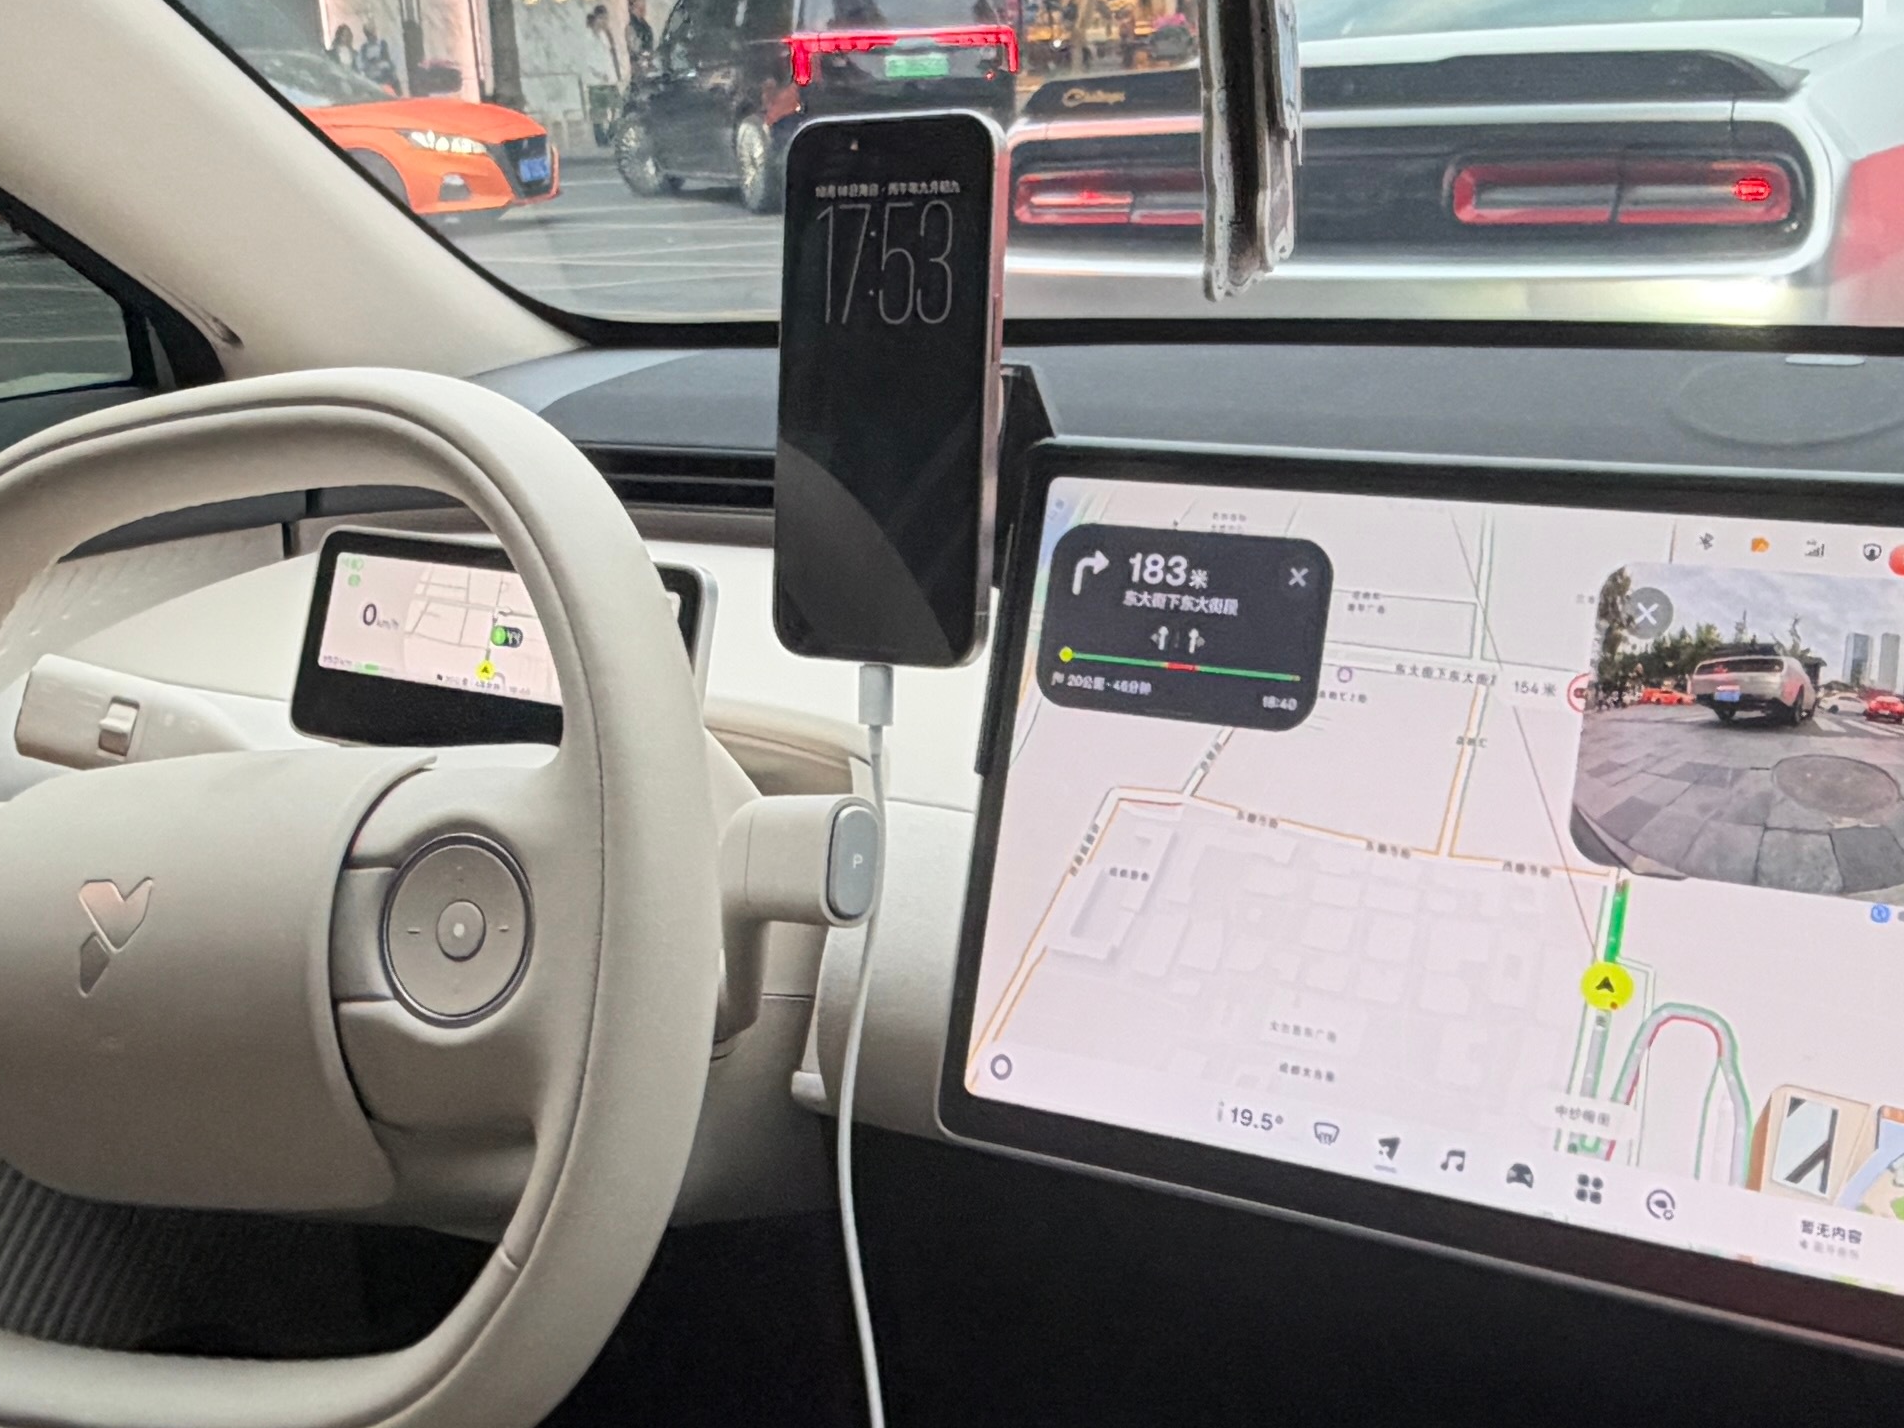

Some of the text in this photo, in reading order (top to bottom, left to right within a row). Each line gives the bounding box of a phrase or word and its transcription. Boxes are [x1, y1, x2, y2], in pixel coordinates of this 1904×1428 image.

[817, 199, 954, 325] 17:53
[362, 602, 378, 627] 0
[1230, 1106, 1285, 1132] 19.5°
